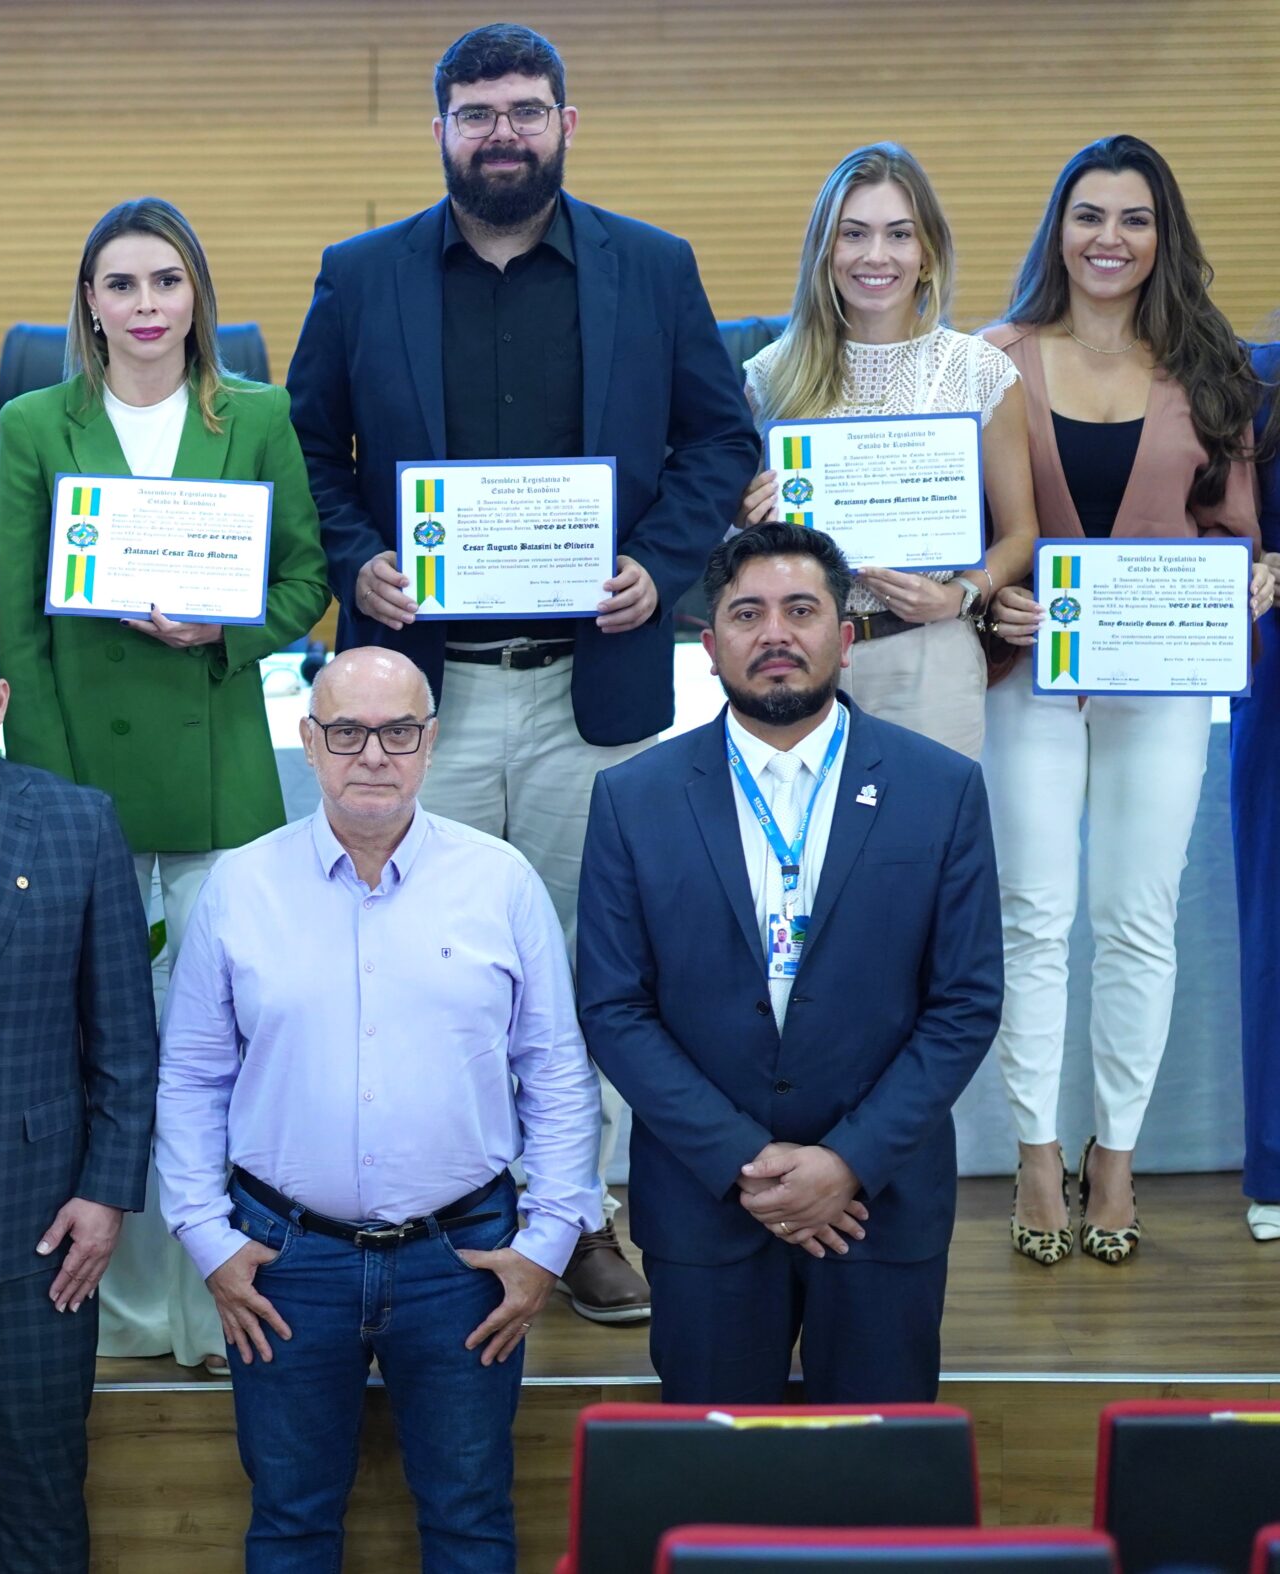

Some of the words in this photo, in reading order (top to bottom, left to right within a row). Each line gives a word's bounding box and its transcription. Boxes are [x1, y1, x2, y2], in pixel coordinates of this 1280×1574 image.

[847, 432, 885, 440] Assembleia
[888, 431, 925, 439] Legislativa
[179, 490, 217, 498] Legislativa
[894, 496, 920, 504] Martins
[487, 544, 518, 552] Augusto
[123, 547, 159, 556] Natanael
[207, 551, 238, 559] Modena
[754, 797, 766, 815] SESAU
